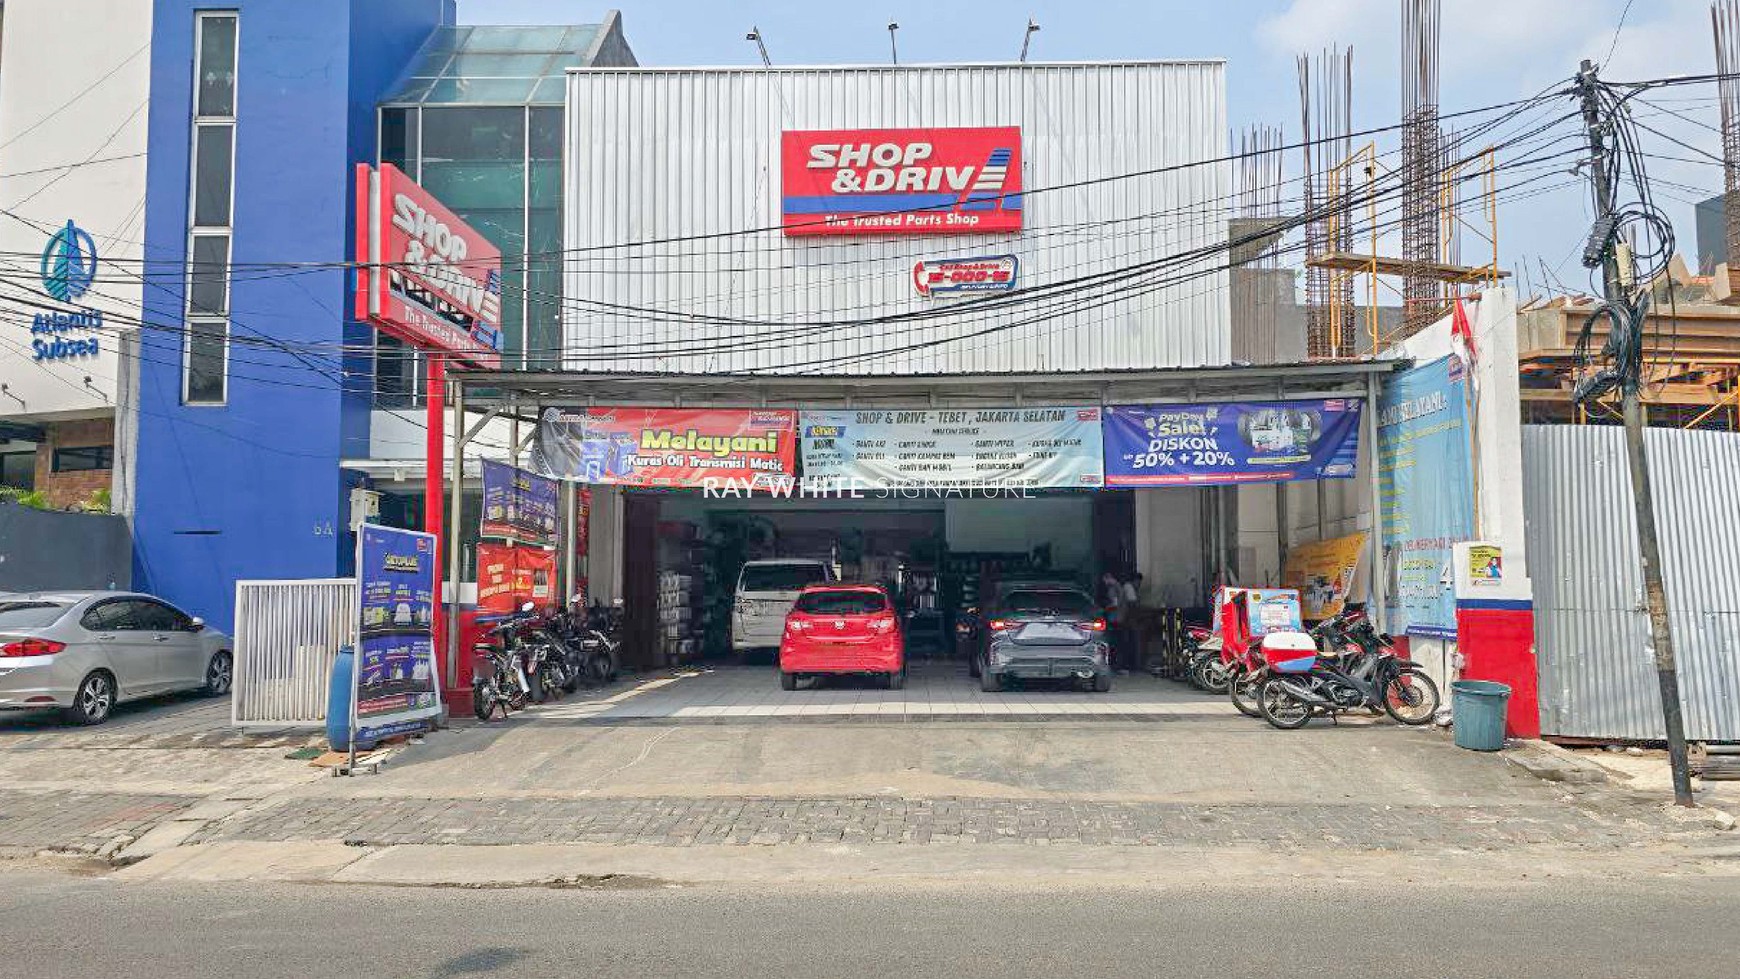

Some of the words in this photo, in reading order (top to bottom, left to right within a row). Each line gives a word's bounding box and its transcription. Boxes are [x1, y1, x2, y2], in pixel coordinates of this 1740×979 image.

[807, 142, 933, 168] SHOP
[392, 192, 468, 263] SHOP
[825, 215, 848, 227] The
[854, 214, 901, 227] Trusted
[906, 214, 942, 226] Parts
[946, 213, 979, 227] Shop
[31, 309, 104, 334] Atlantis
[31, 336, 99, 360] Subsea
[856, 411, 883, 424] SHOP
[885, 411, 894, 424] &
[896, 411, 927, 424] DRIVE
[975, 410, 1020, 423] JAKARTA
[1023, 409, 1065, 422] SELATAN
[1158, 420, 1206, 436] Sale!
[1148, 437, 1218, 453] DISKON
[626, 454, 662, 467] Kuras
[667, 455, 684, 467] Oli
[688, 455, 746, 469] Transmisi
[750, 458, 784, 472] Matic
[1132, 451, 1175, 469] 50%
[1180, 453, 1190, 465] +
[1192, 450, 1236, 466] 20%
